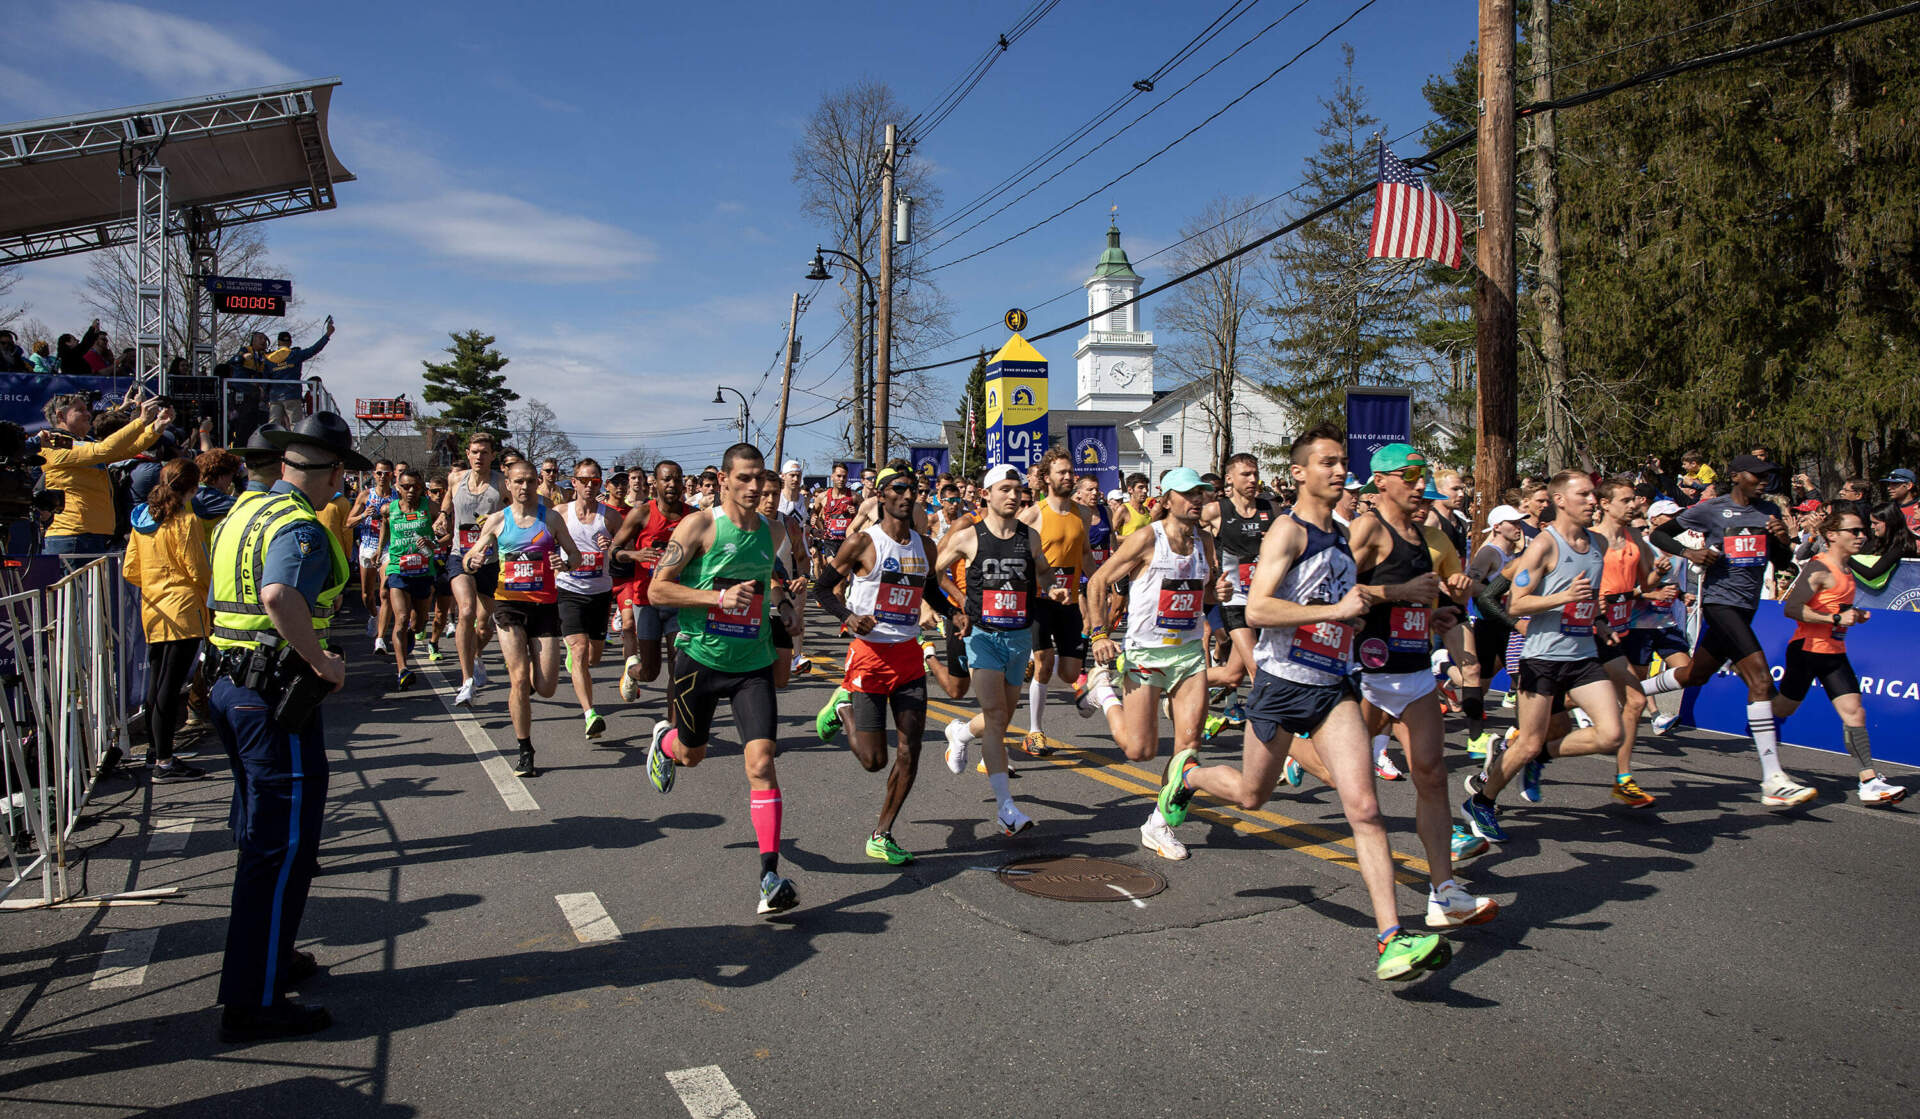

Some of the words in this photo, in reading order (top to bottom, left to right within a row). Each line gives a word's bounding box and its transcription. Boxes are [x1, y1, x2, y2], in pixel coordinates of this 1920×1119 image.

[226, 295, 276, 311] 10:00:05
[394, 521, 426, 531] RUNNING
[242, 510, 273, 596] POLICE
[1735, 537, 1757, 552] 912
[888, 587, 914, 607] 567
[1170, 593, 1195, 612] 252
[1770, 665, 1785, 681] O
[1860, 676, 1920, 700] RICA
